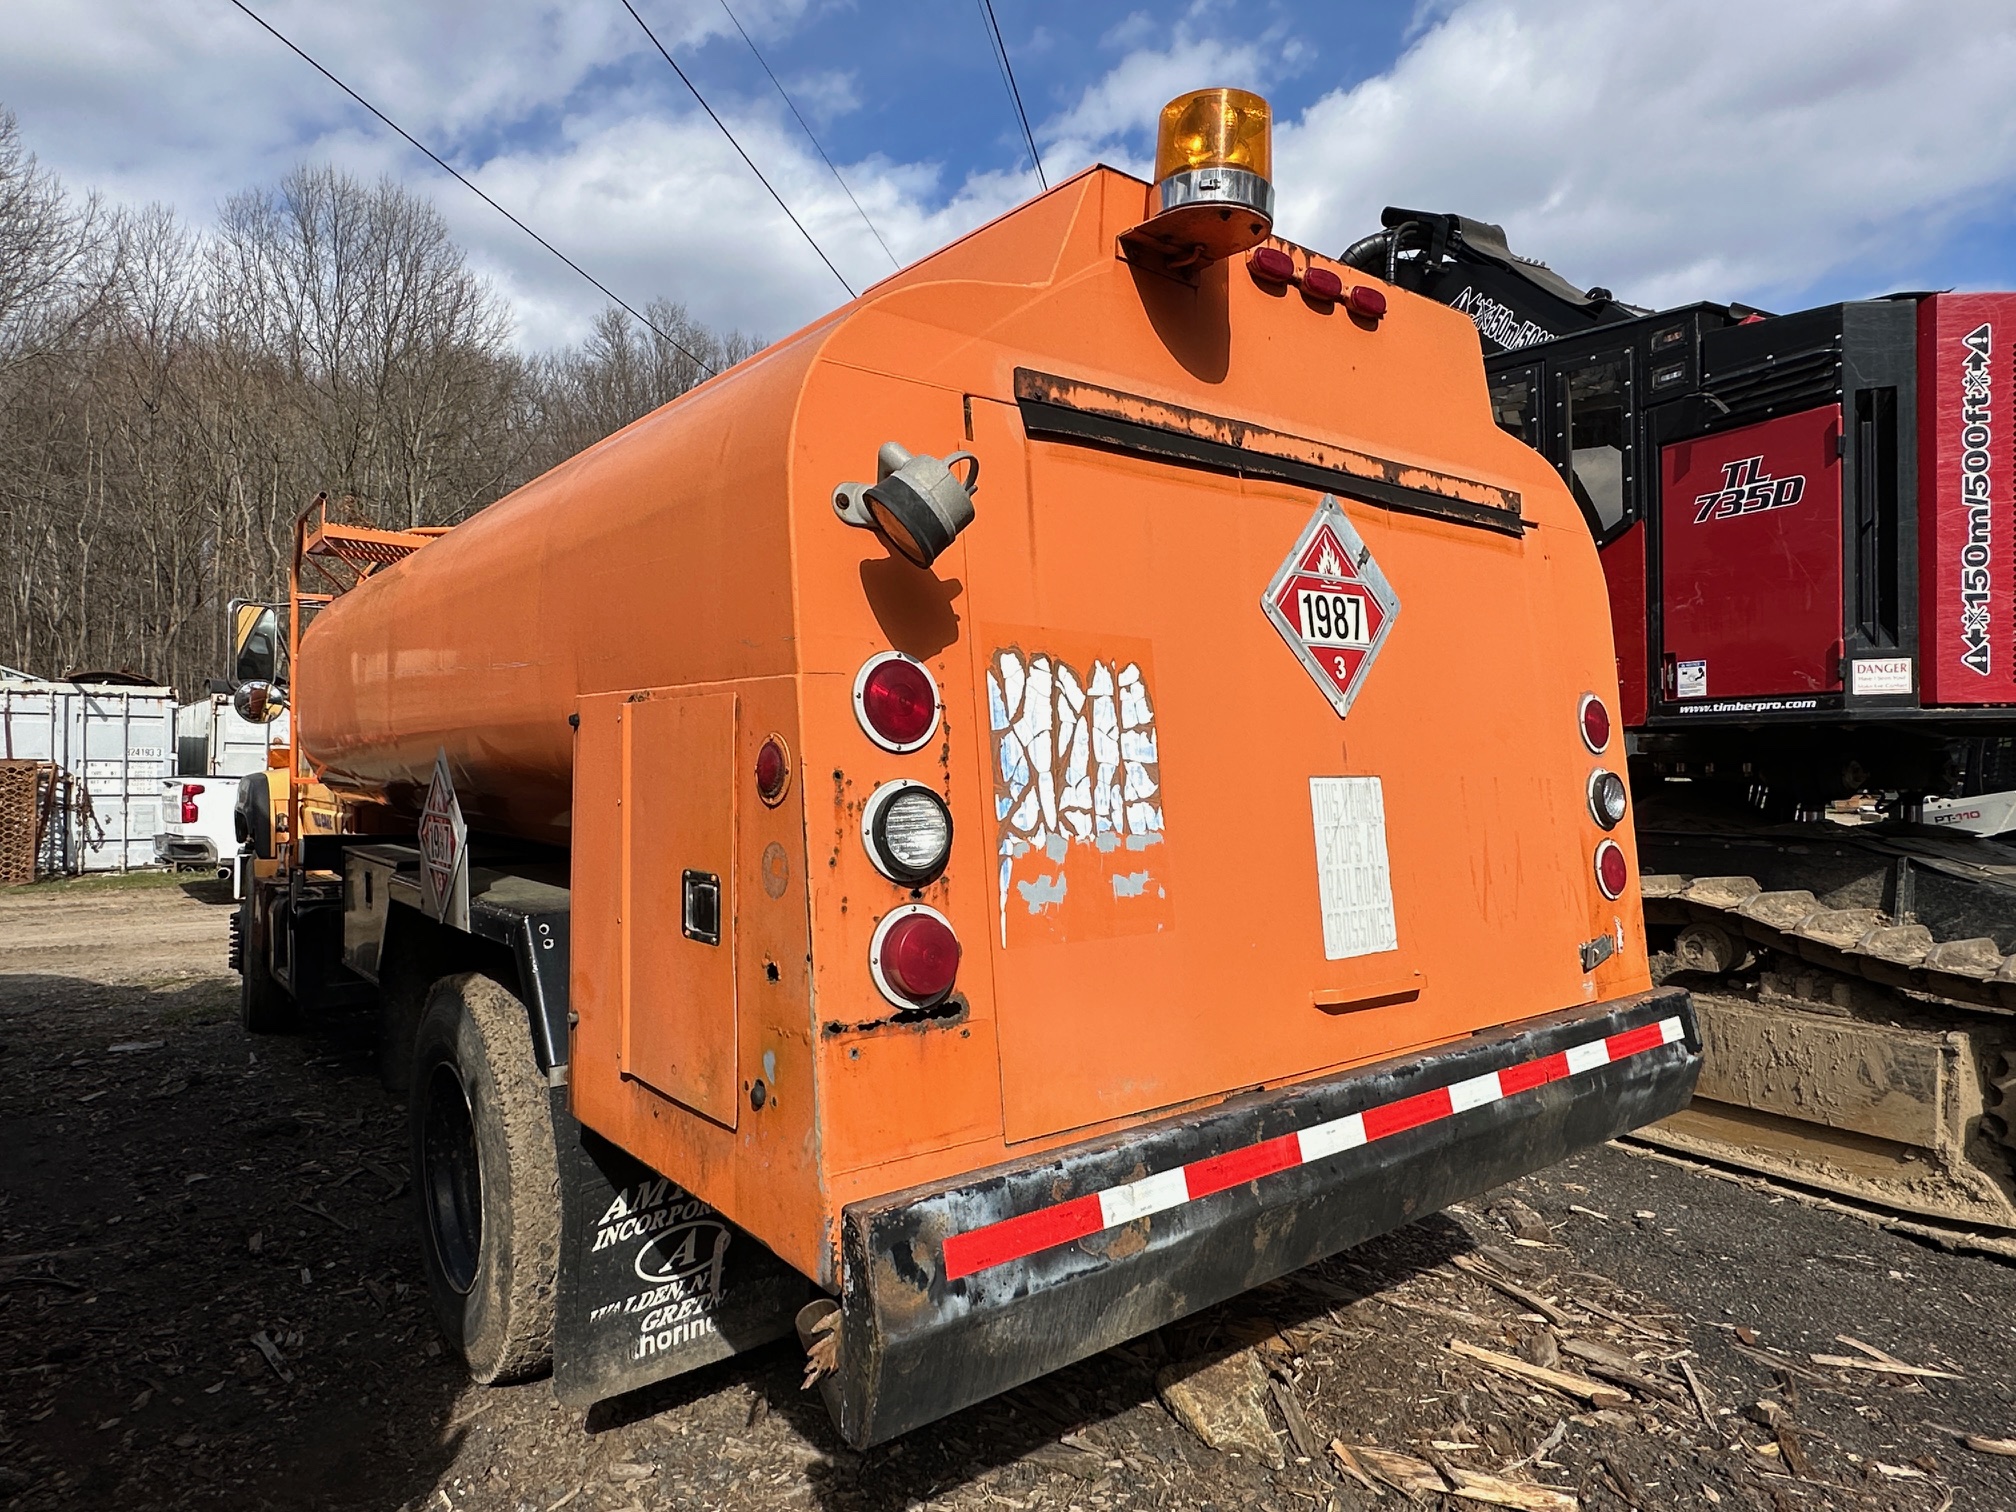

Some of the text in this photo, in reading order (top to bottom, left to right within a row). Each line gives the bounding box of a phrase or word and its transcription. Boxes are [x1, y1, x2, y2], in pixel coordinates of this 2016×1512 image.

[1483, 303, 1560, 350] 150m/50
[1721, 455, 1772, 491] TL
[1694, 475, 1806, 524] 735D
[1963, 390, 1990, 609] 150m/500ft
[1303, 593, 1360, 641] 1987
[1334, 656, 1347, 680] 3
[1857, 663, 1907, 674] DANGER
[1680, 700, 1817, 713] www.timberpro.com
[1313, 782, 1339, 822] THIS
[1934, 810, 1981, 823] PT-110
[1323, 823, 1380, 866] STOPS AT
[1325, 865, 1387, 910] RAILROAD
[1326, 907, 1392, 953] CROSSINGS
[591, 1201, 717, 1253] INCORPOR
[658, 1227, 697, 1274] A
